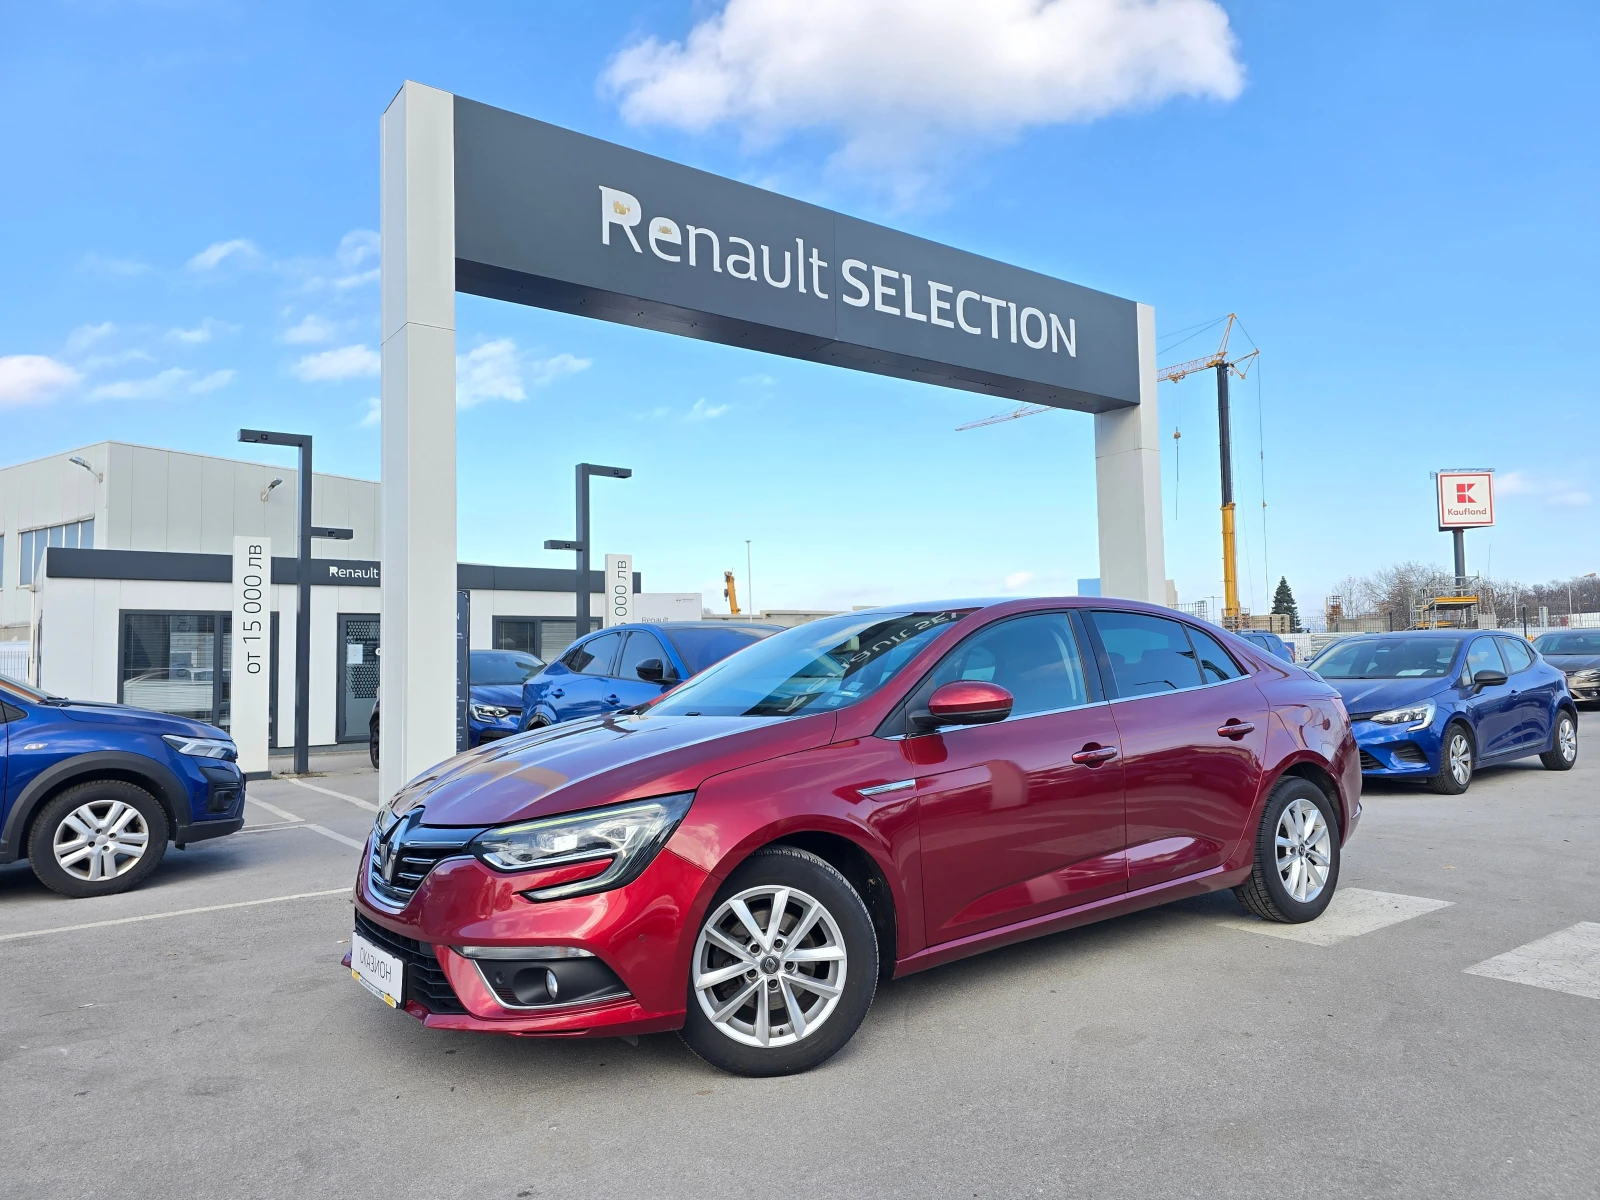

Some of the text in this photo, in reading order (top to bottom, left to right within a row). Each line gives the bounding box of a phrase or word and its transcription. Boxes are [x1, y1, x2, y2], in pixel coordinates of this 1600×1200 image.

[598, 184, 1078, 359] Renault SELECTION
[1447, 508, 1487, 516] Kaufland
[328, 565, 379, 579] Renault
[243, 575, 262, 614] 000
[614, 584, 628, 617] 000
[243, 620, 262, 644] 15
